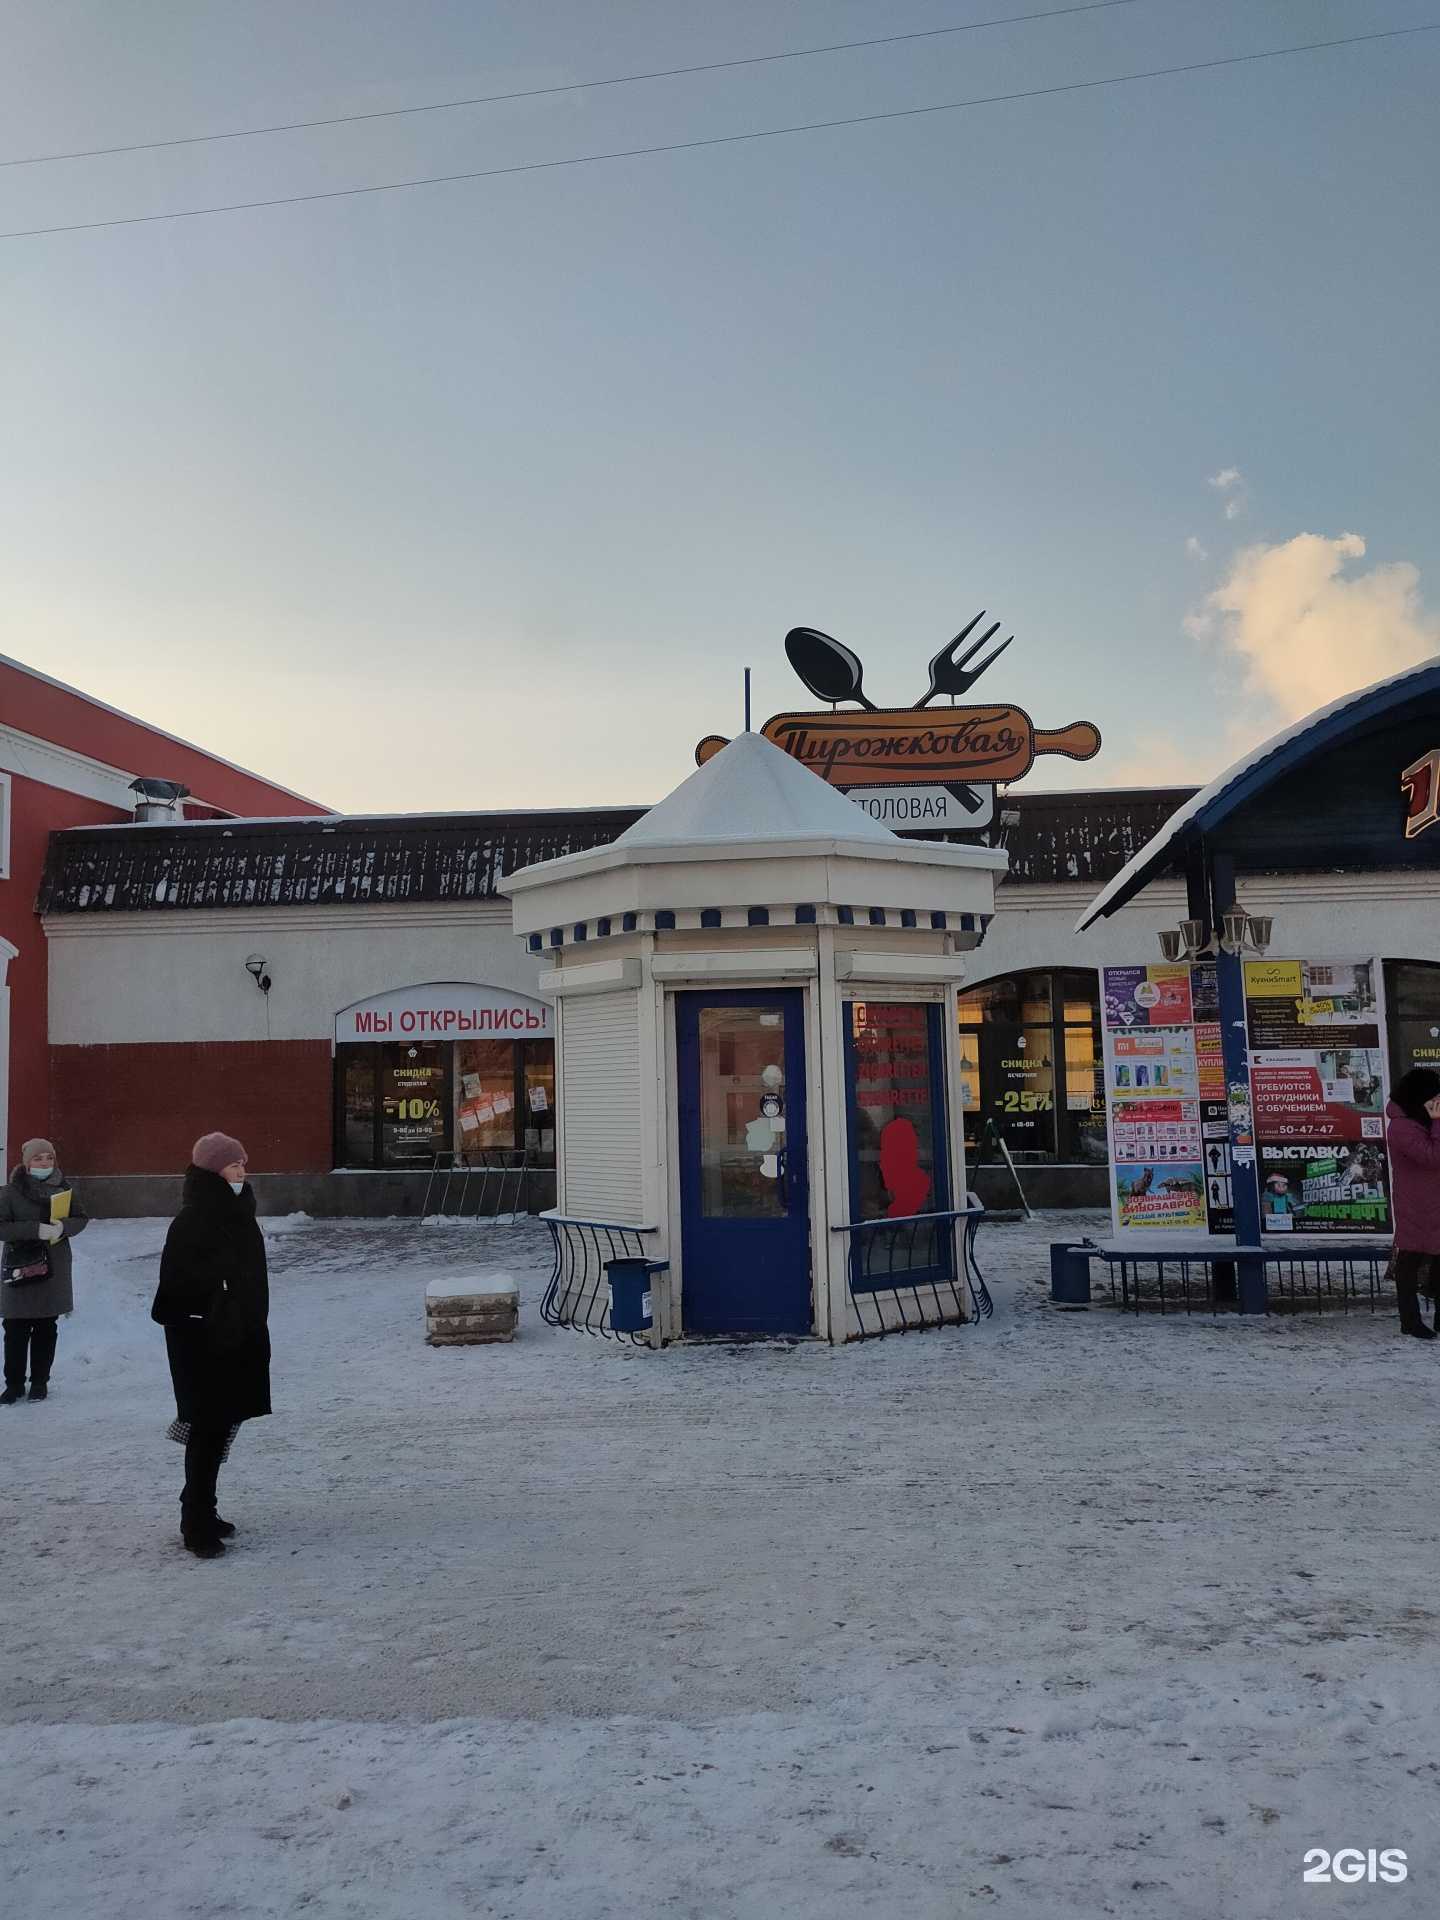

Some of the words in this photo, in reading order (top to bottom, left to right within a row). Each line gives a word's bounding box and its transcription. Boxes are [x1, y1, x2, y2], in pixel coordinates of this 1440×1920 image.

[775, 714, 1025, 780] Пирожковая
[853, 797, 947, 820] ТОЛОВАЯ
[355, 1011, 393, 1033] МЫ
[400, 1008, 547, 1032] ОТКРЫЛИСЬ!
[1001, 1058, 1043, 1070] СКИДКА
[393, 1067, 432, 1079] СКИДКА
[1256, 1083, 1312, 1091] ТРЕБУЮТСЯ
[994, 1090, 1053, 1113] -25%
[1256, 1093, 1320, 1102] СОТРУДНИКИ
[386, 1098, 440, 1120] -10%
[1266, 1104, 1327, 1112] ОБУЧЕНИЕМ!
[1280, 1125, 1334, 1134] 50-47-47
[1262, 1146, 1350, 1159] ВЫСТАВКА
